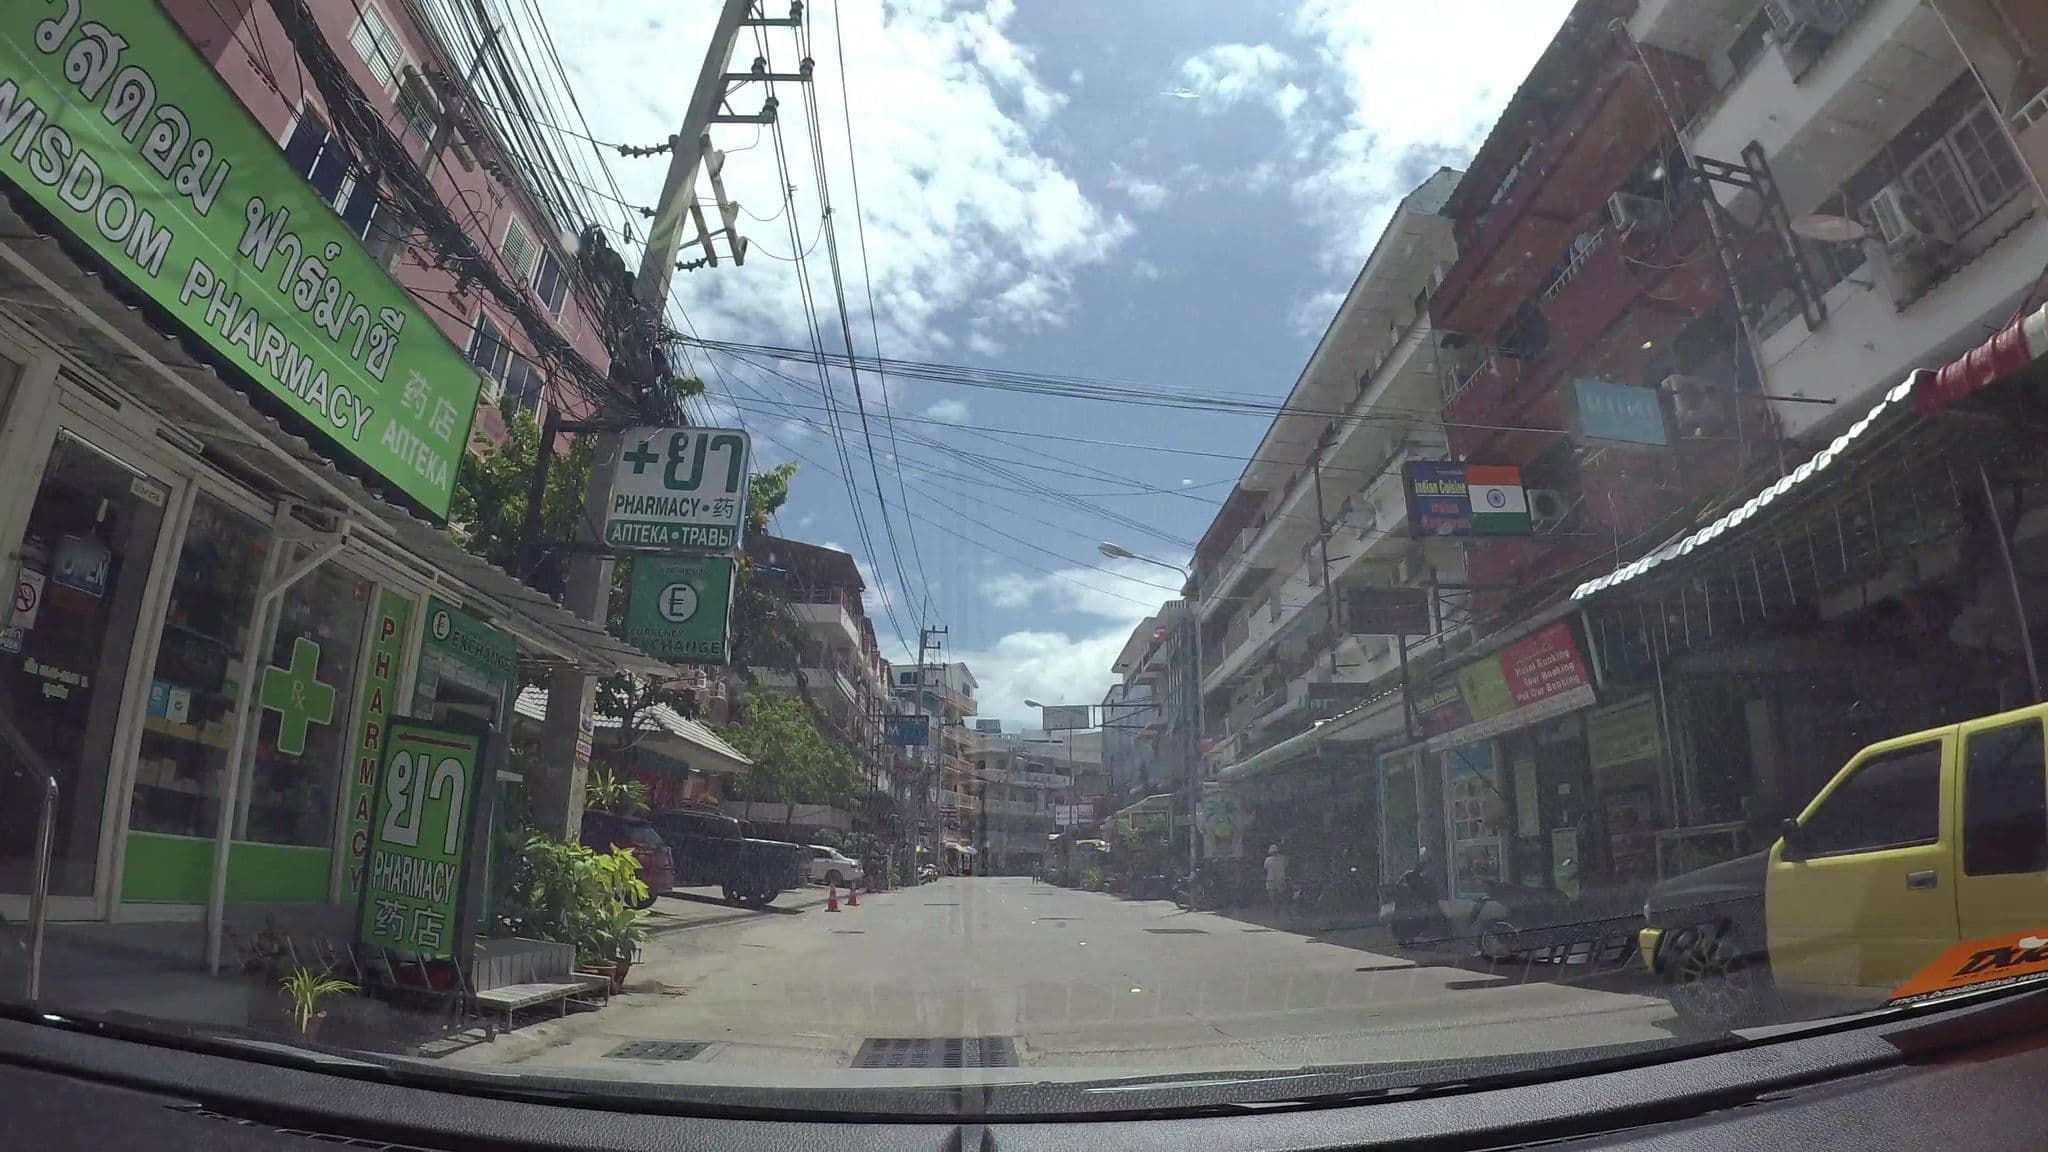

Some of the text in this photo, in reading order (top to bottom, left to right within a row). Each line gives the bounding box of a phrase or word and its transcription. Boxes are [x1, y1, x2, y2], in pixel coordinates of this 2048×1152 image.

[180, 258, 375, 442] PHARMACY
[400, 368, 458, 443] 药店
[381, 418, 449, 492] АПТЕКА
[663, 431, 744, 493] ยา
[1439, 480, 1466, 495] Cuisine
[614, 494, 699, 518] PHARMACY
[713, 498, 734, 519] 药
[611, 523, 734, 547] АПТЕКА ТРАВЫ
[630, 638, 720, 654] EXCHANGE
[1515, 649, 1570, 677] Hotel Booking
[1541, 662, 1575, 680] Booking
[1545, 674, 1581, 692] Booking
[382, 750, 466, 856] ยา
[372, 851, 457, 904] PHARMACY
[374, 899, 445, 950] 药店
